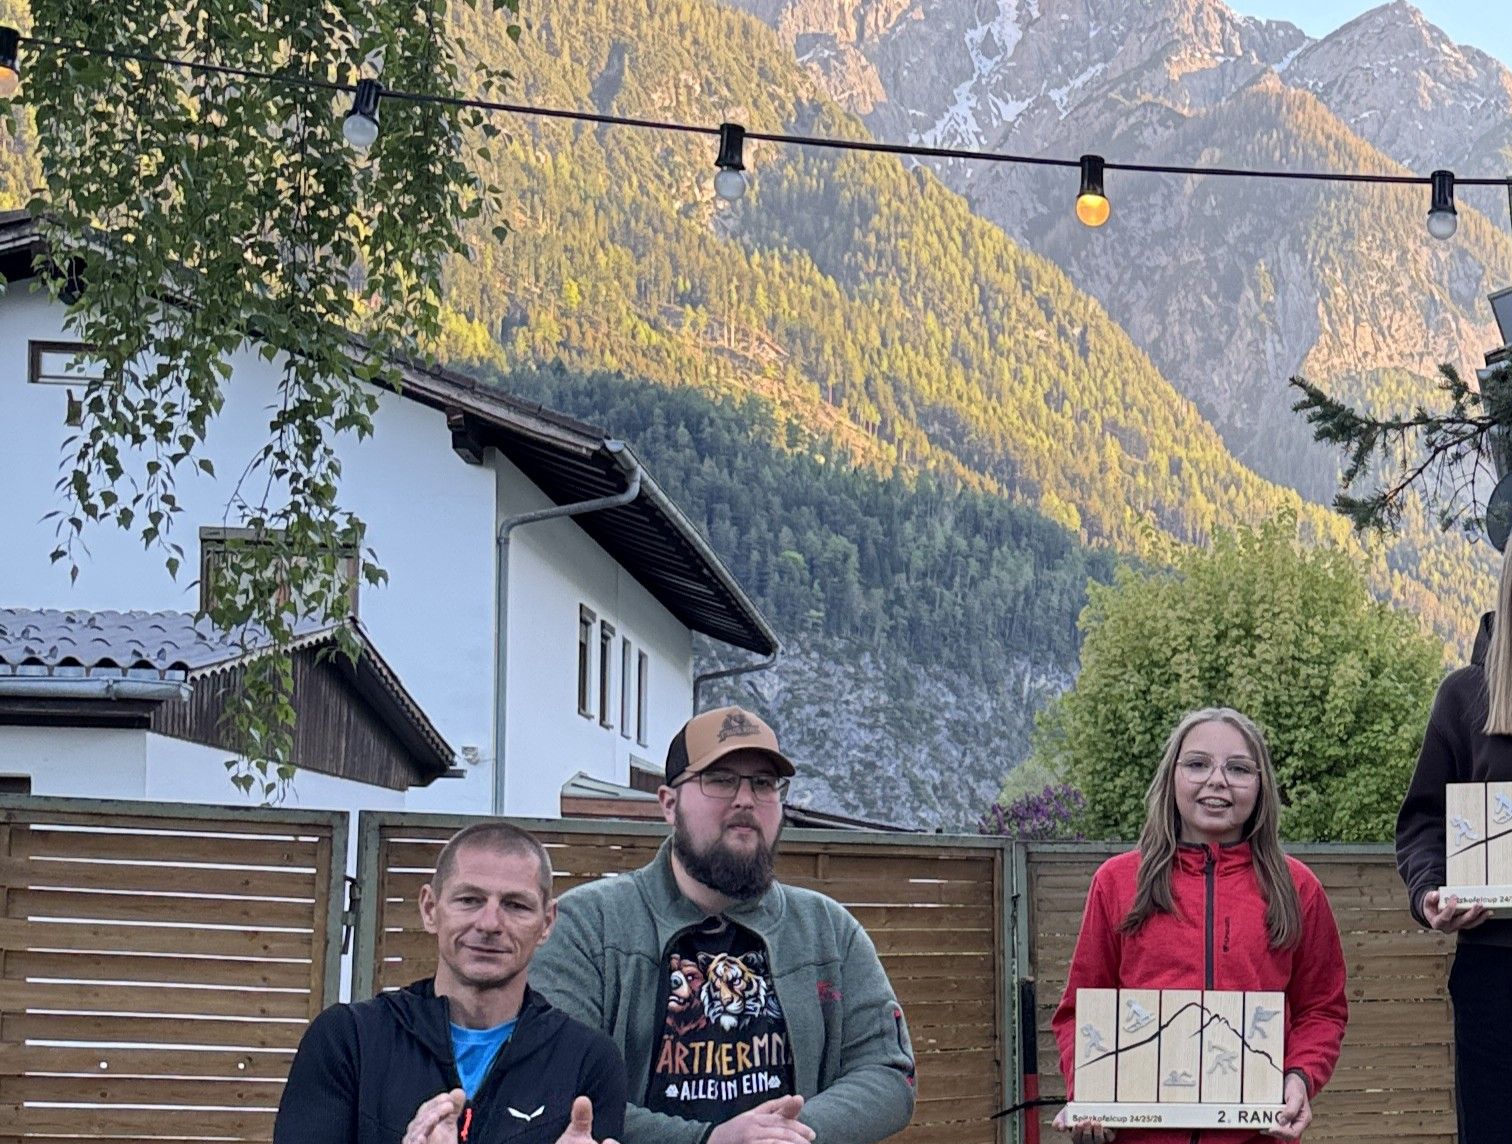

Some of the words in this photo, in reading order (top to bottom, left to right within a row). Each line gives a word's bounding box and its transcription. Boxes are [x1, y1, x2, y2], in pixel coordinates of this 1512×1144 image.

[1444, 895, 1498, 905] Stzkofelcup
[721, 1079, 738, 1101] IN
[1129, 1114, 1163, 1123] 24/25/26
